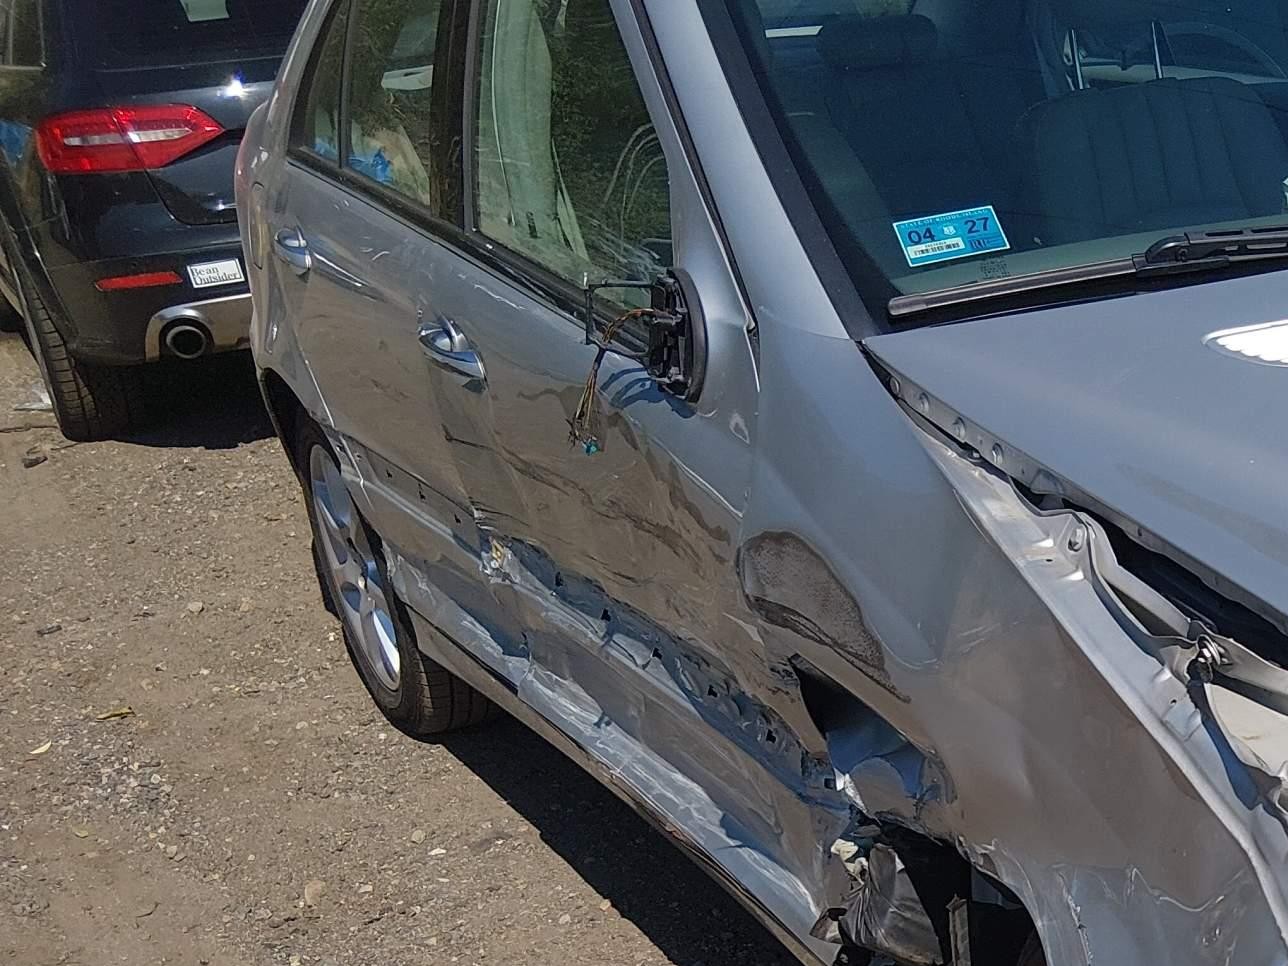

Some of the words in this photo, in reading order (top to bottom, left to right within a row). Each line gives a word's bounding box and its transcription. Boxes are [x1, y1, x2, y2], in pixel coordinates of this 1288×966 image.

[907, 227, 935, 244] 04
[964, 216, 990, 234] 27
[191, 267, 219, 276] Bean
[193, 272, 239, 285] Outsider
